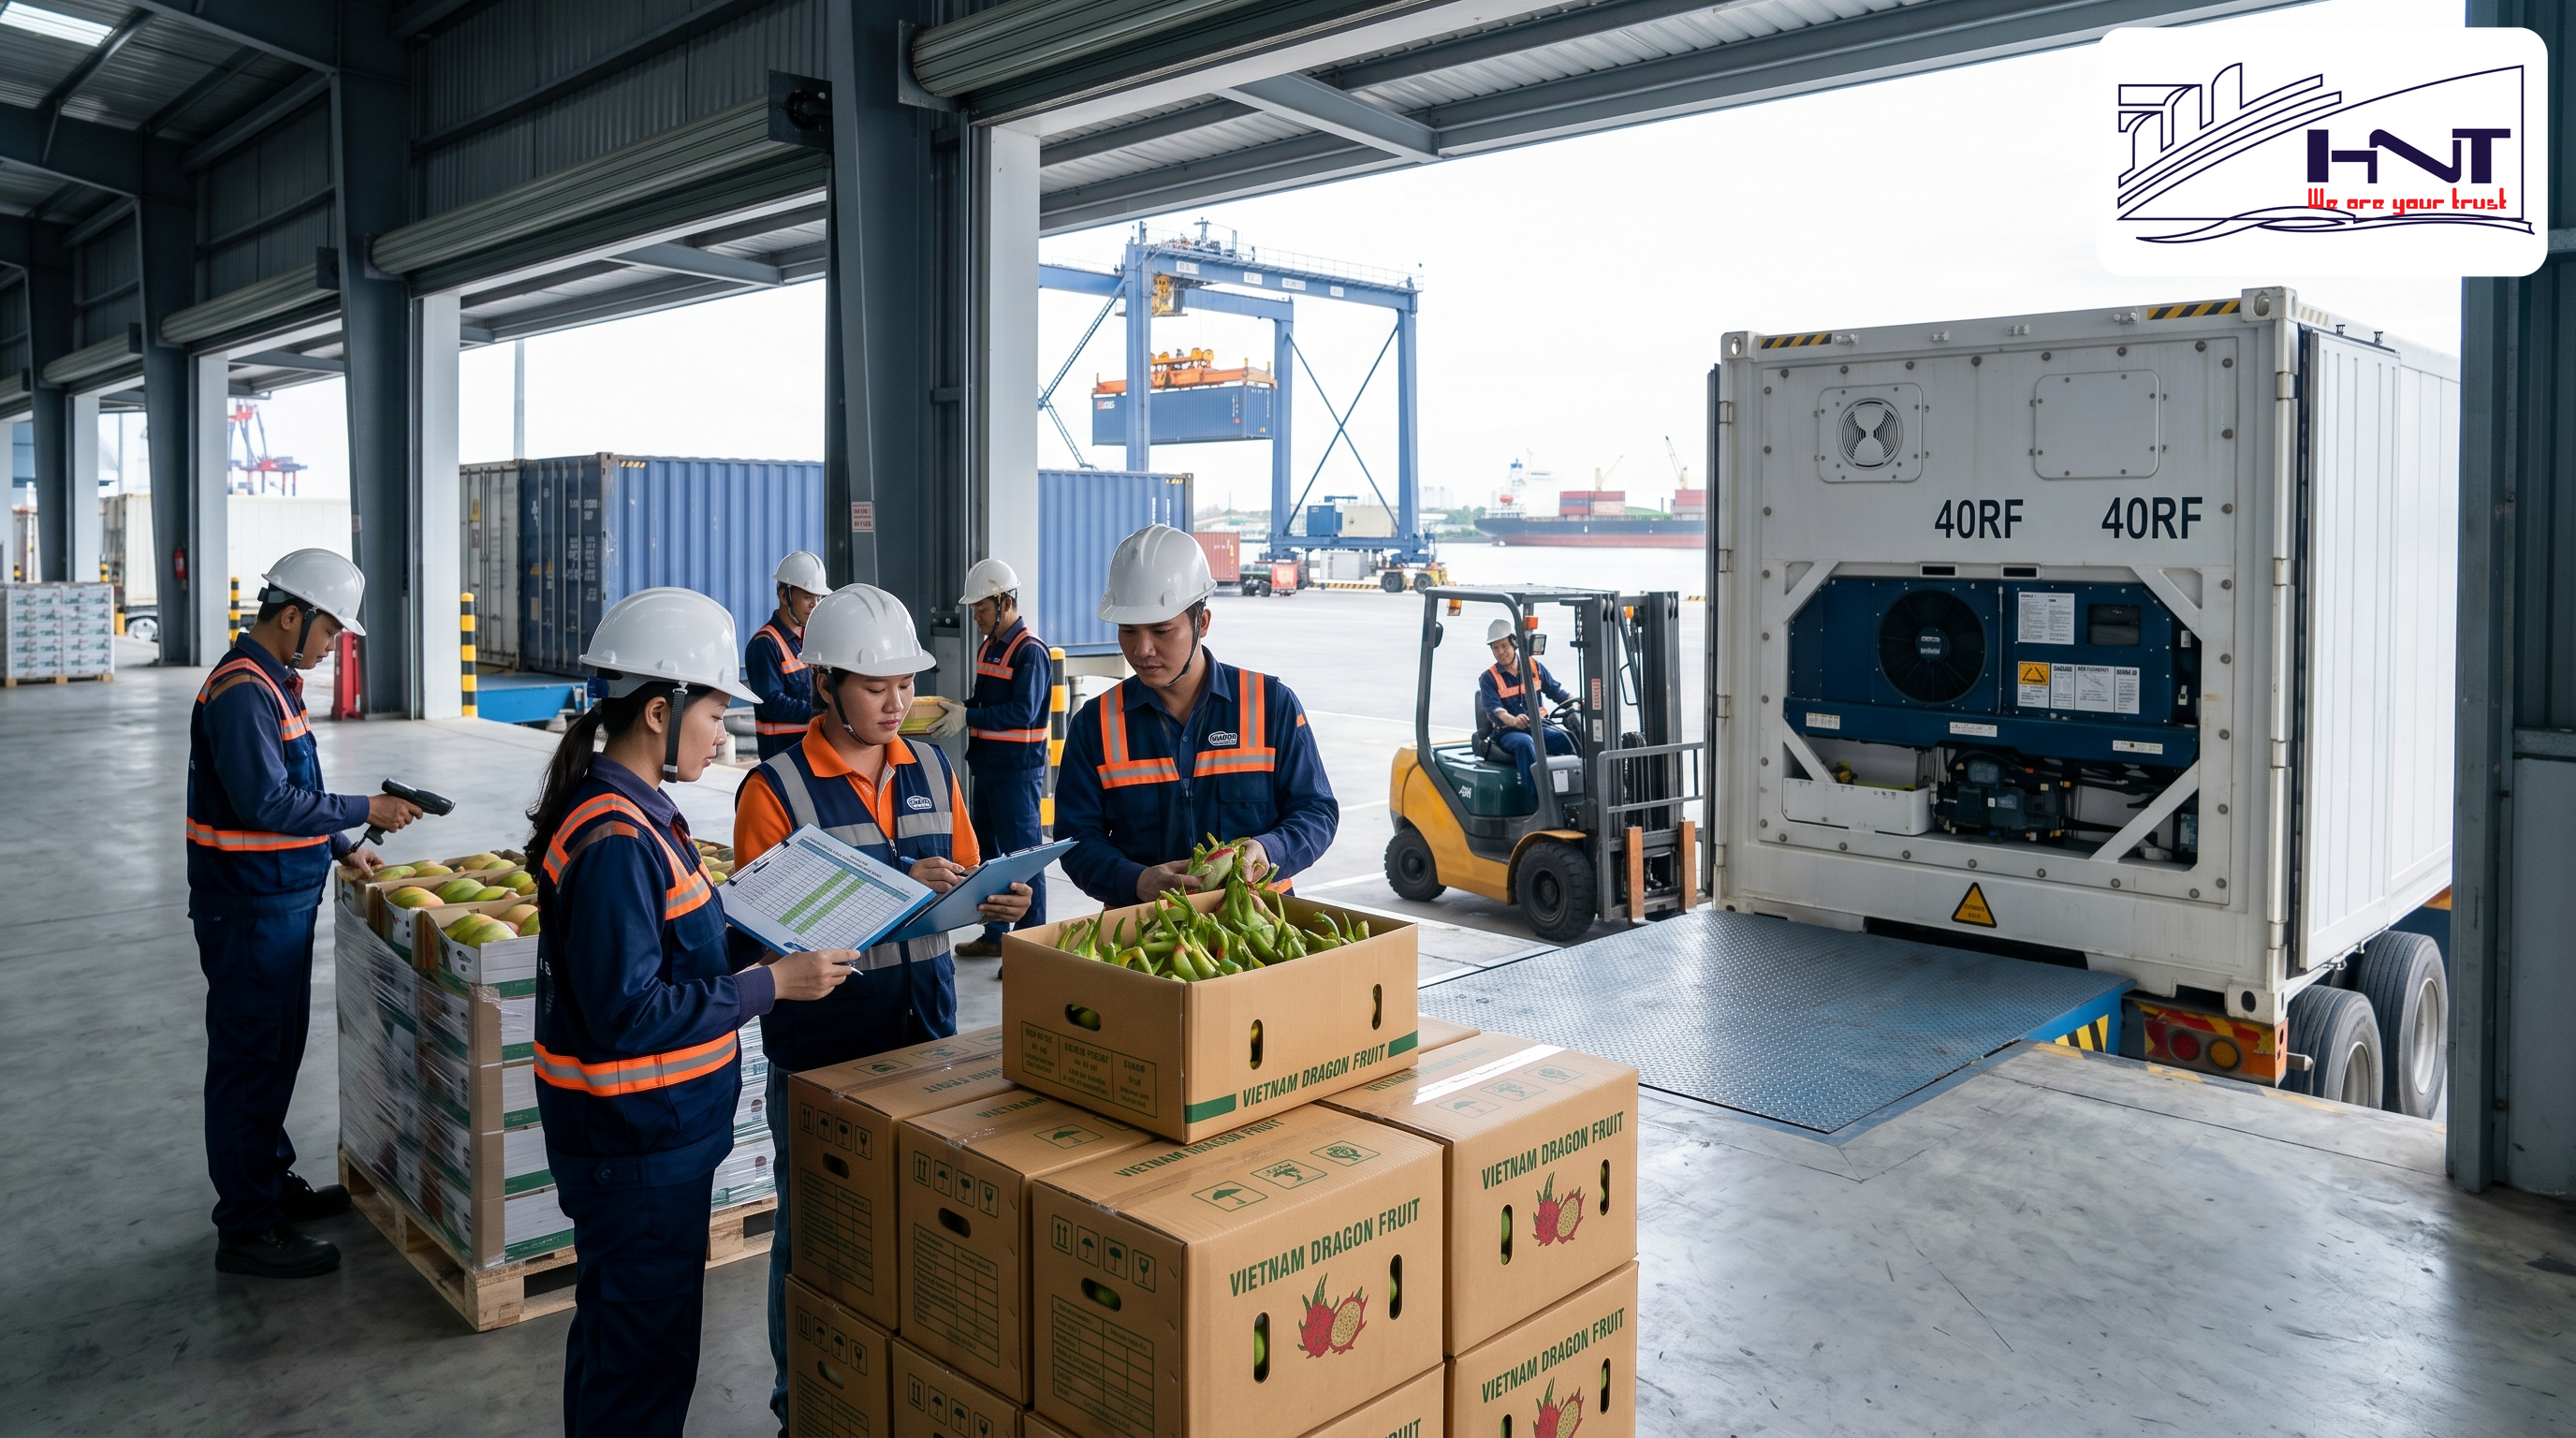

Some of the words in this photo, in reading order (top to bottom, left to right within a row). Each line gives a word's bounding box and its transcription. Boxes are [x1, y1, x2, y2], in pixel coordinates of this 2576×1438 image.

[1934, 499, 2024, 539] 40RF
[2101, 496, 2203, 539] 40RF
[1243, 1073, 1299, 1108] VIETNAM
[1301, 1056, 1350, 1088] DRAGON
[1353, 1043, 1385, 1070] FRUIT
[1482, 1148, 1537, 1190] VIETNAM
[1542, 1126, 1588, 1166] DRAGON
[1592, 1110, 1624, 1143] FRUIT
[1230, 1245, 1305, 1298] VIETNAM
[1310, 1217, 1373, 1265] DRAGON
[1379, 1197, 1420, 1237] FRUIT
[1482, 1356, 1537, 1403] VIETNAM
[1542, 1328, 1588, 1372] DRAGON
[1592, 1308, 1624, 1343] FRUIT
